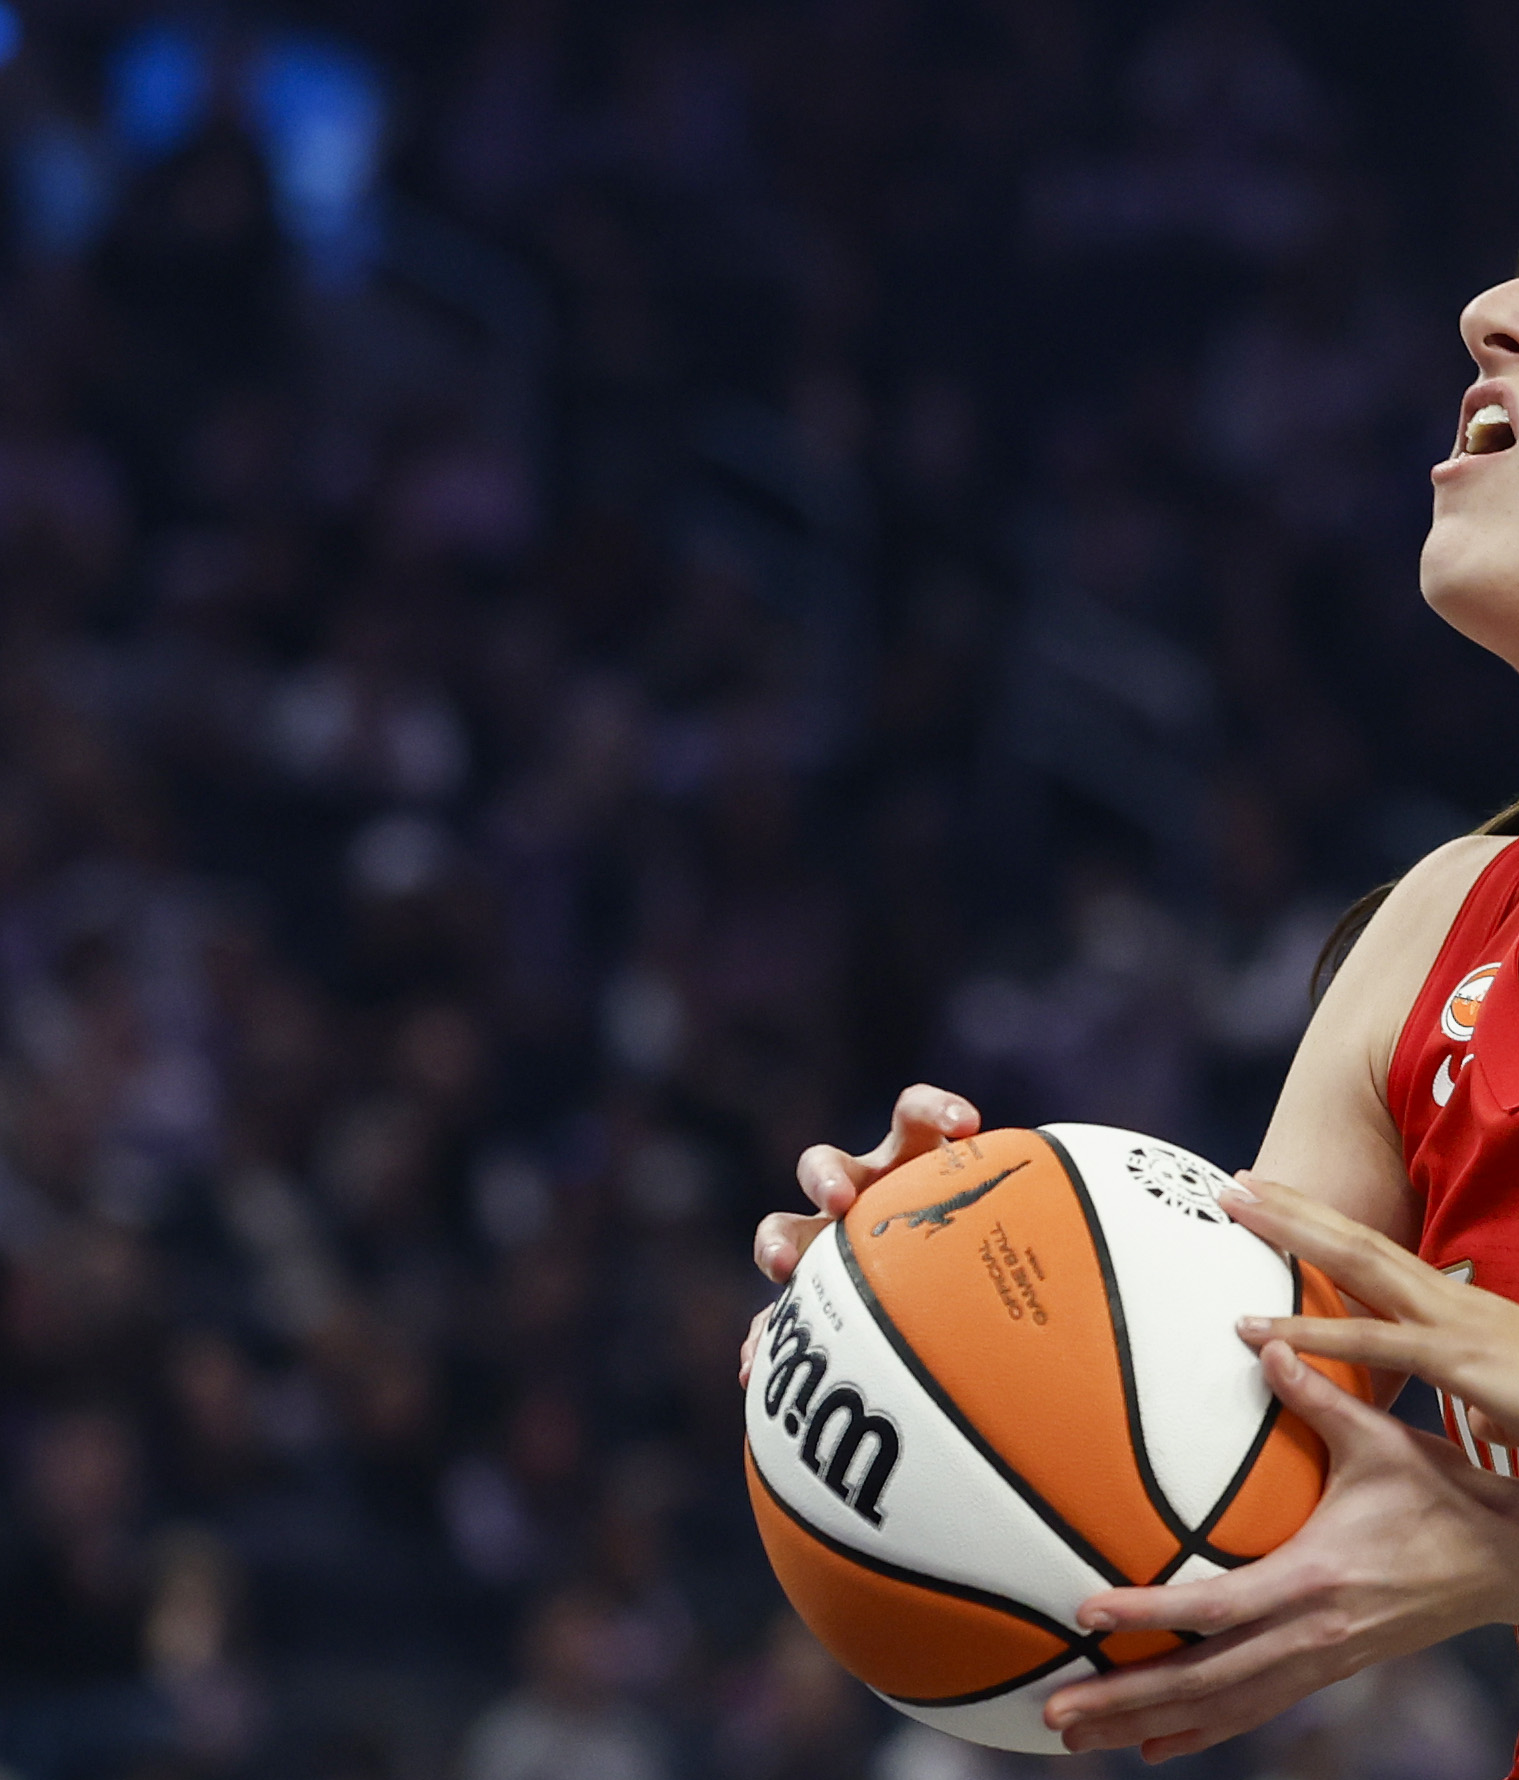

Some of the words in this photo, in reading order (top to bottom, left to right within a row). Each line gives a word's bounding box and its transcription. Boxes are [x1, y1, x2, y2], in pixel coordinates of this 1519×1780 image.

[989, 1221, 1019, 1267] BALL
[979, 1239, 1024, 1321] OFFICIAL
[1010, 1266, 1049, 1327] GAME
